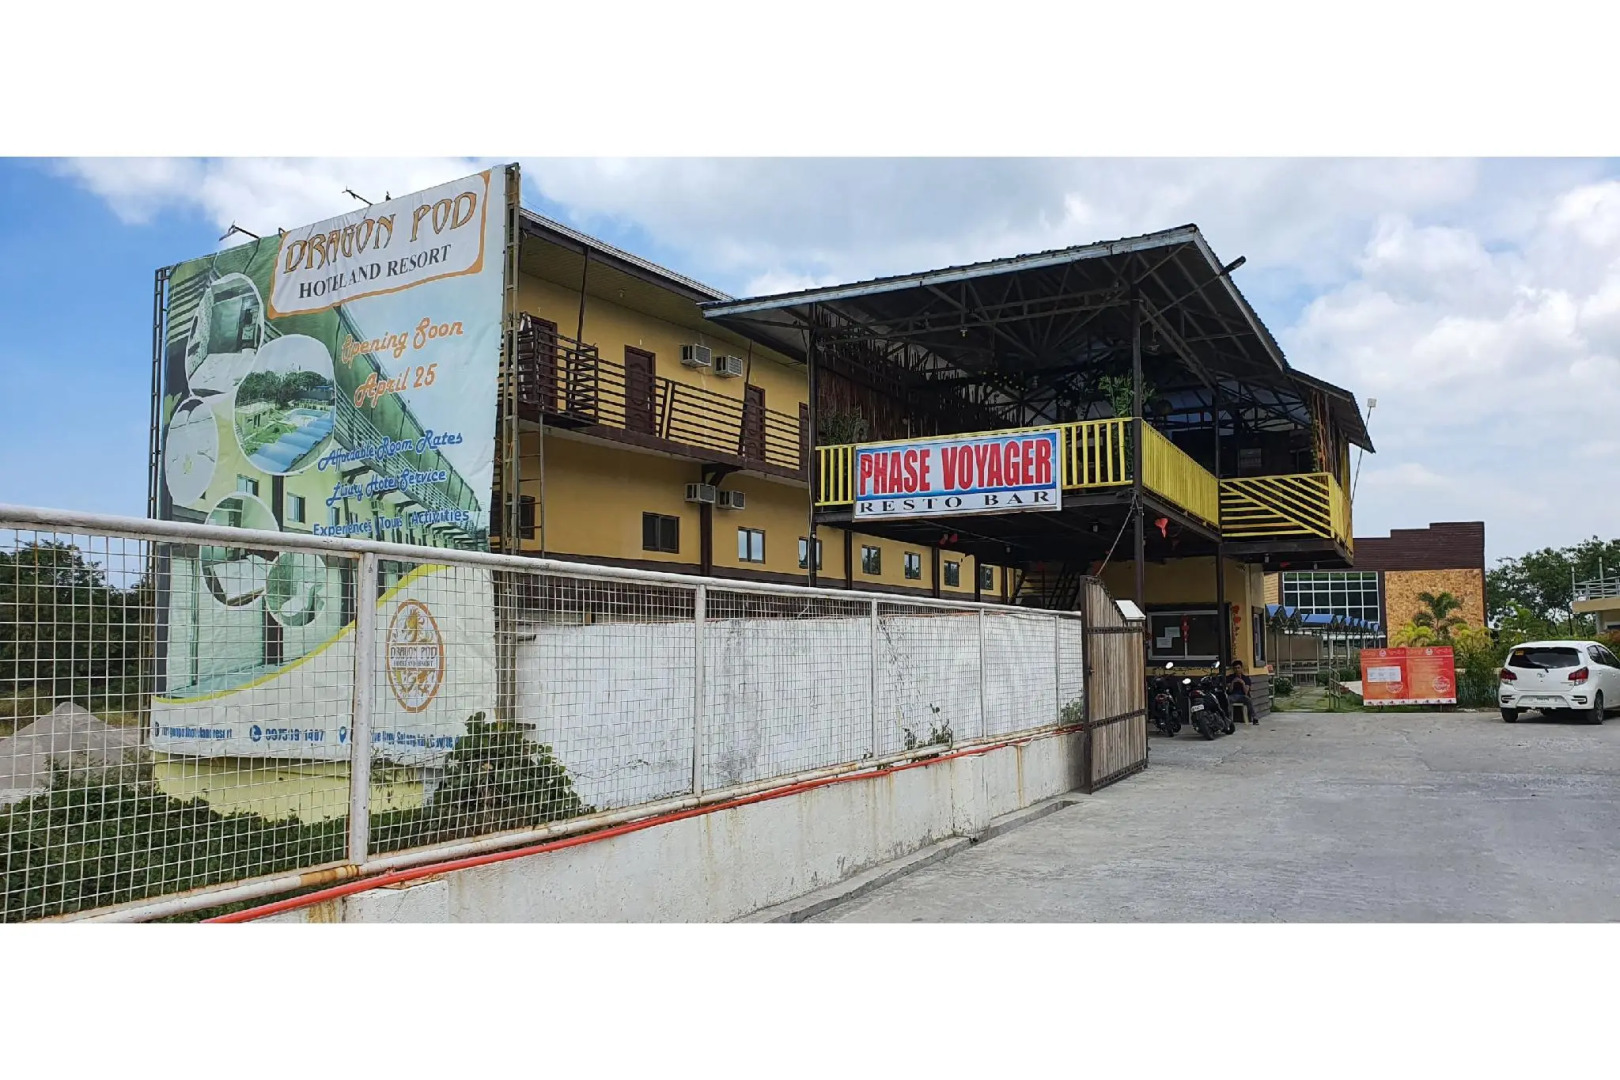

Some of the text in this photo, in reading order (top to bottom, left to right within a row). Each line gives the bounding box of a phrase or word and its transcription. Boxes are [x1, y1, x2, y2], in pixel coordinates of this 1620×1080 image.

[283, 191, 477, 274] DRAGON POD
[298, 244, 451, 298] HOTEL AND RESORT
[341, 317, 464, 369] Opening Soon
[353, 363, 437, 408] April 25
[318, 429, 463, 471] Affordable Room Rates
[859, 438, 1052, 496] PHASE VOYAGER
[326, 468, 447, 506] Luury Hotel Service
[860, 490, 1049, 513] RESTO BAR
[411, 509, 470, 524] Activities
